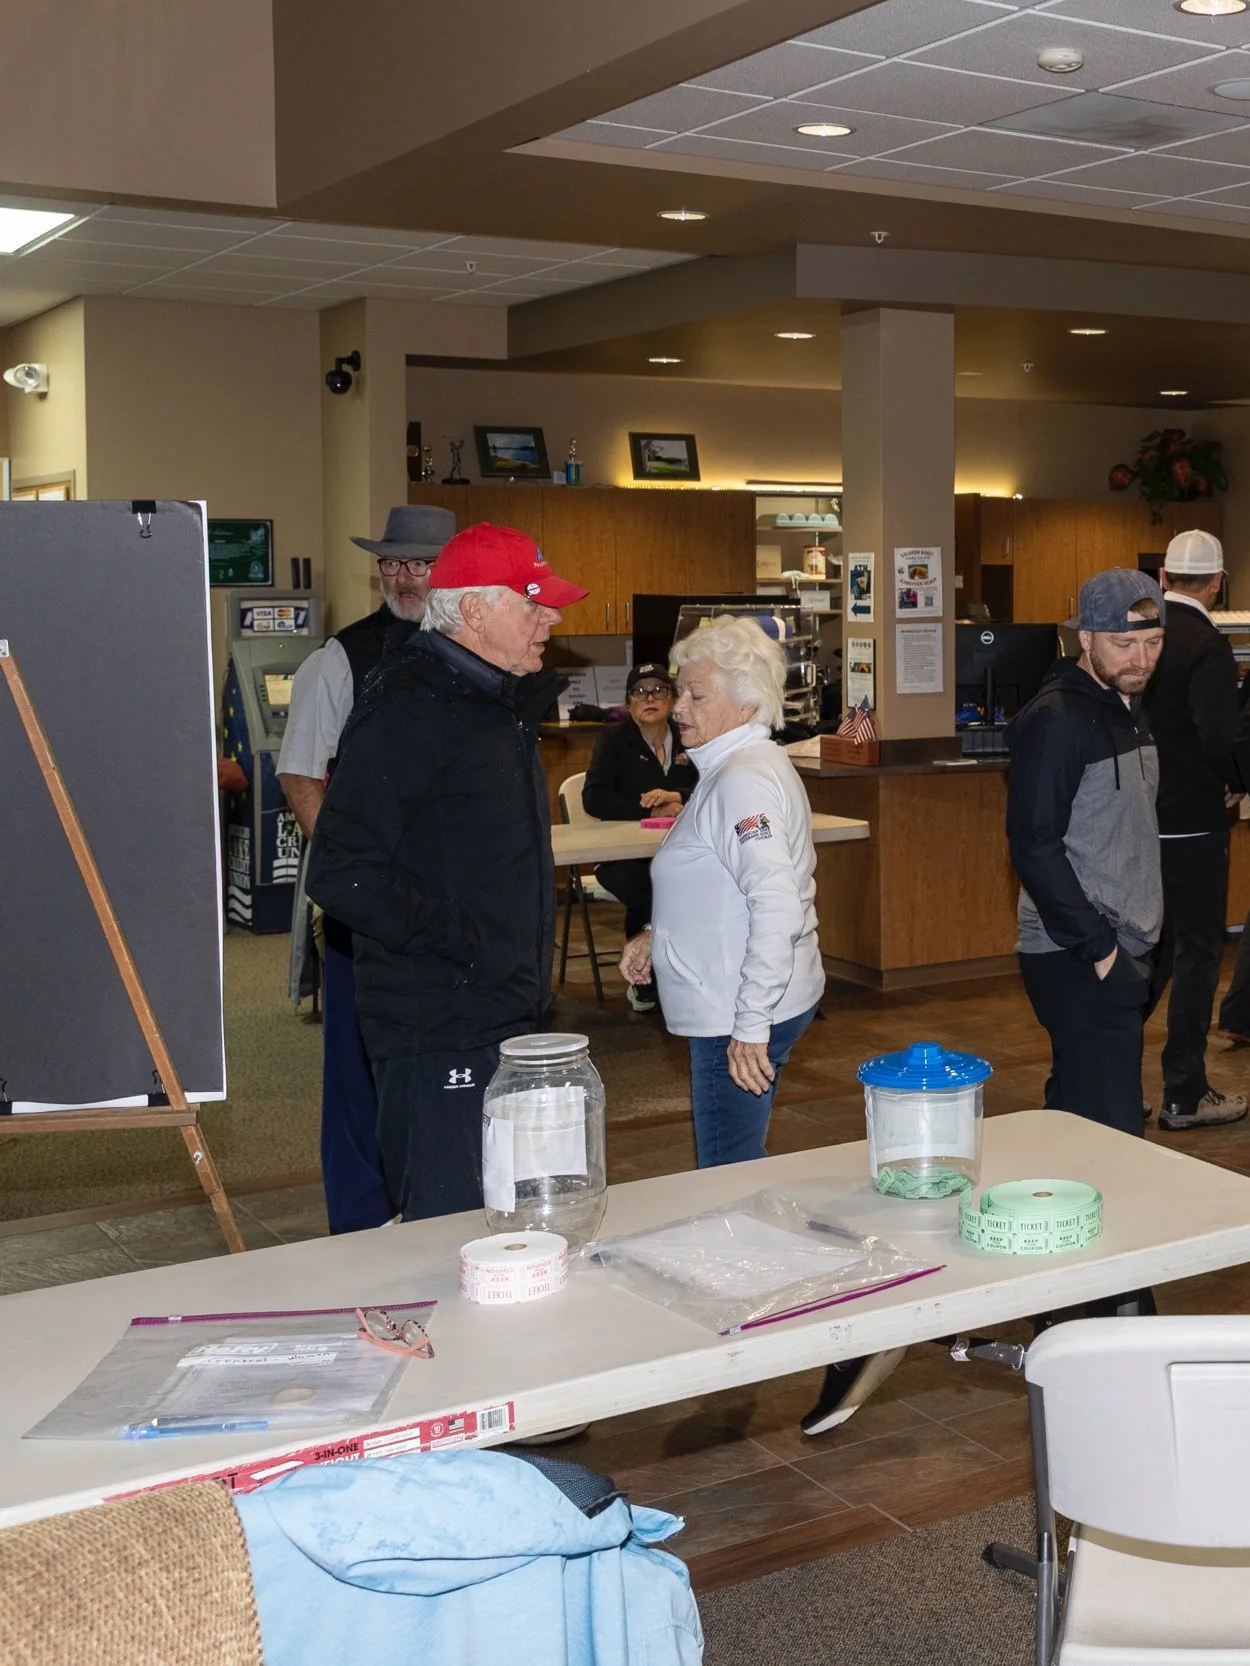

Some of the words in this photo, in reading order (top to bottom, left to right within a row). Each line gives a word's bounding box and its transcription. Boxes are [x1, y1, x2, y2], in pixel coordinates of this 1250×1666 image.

[987, 1219, 1006, 1230] TICKET
[1020, 1222, 1042, 1231] TICKET
[1056, 1217, 1076, 1229] TICKET
[987, 1242, 1007, 1250] COUPON
[1056, 1241, 1076, 1249] COUPON
[487, 1290, 512, 1299] TICKET
[528, 1283, 550, 1296] TICKET
[315, 1442, 359, 1461] 3-IN-ONE
